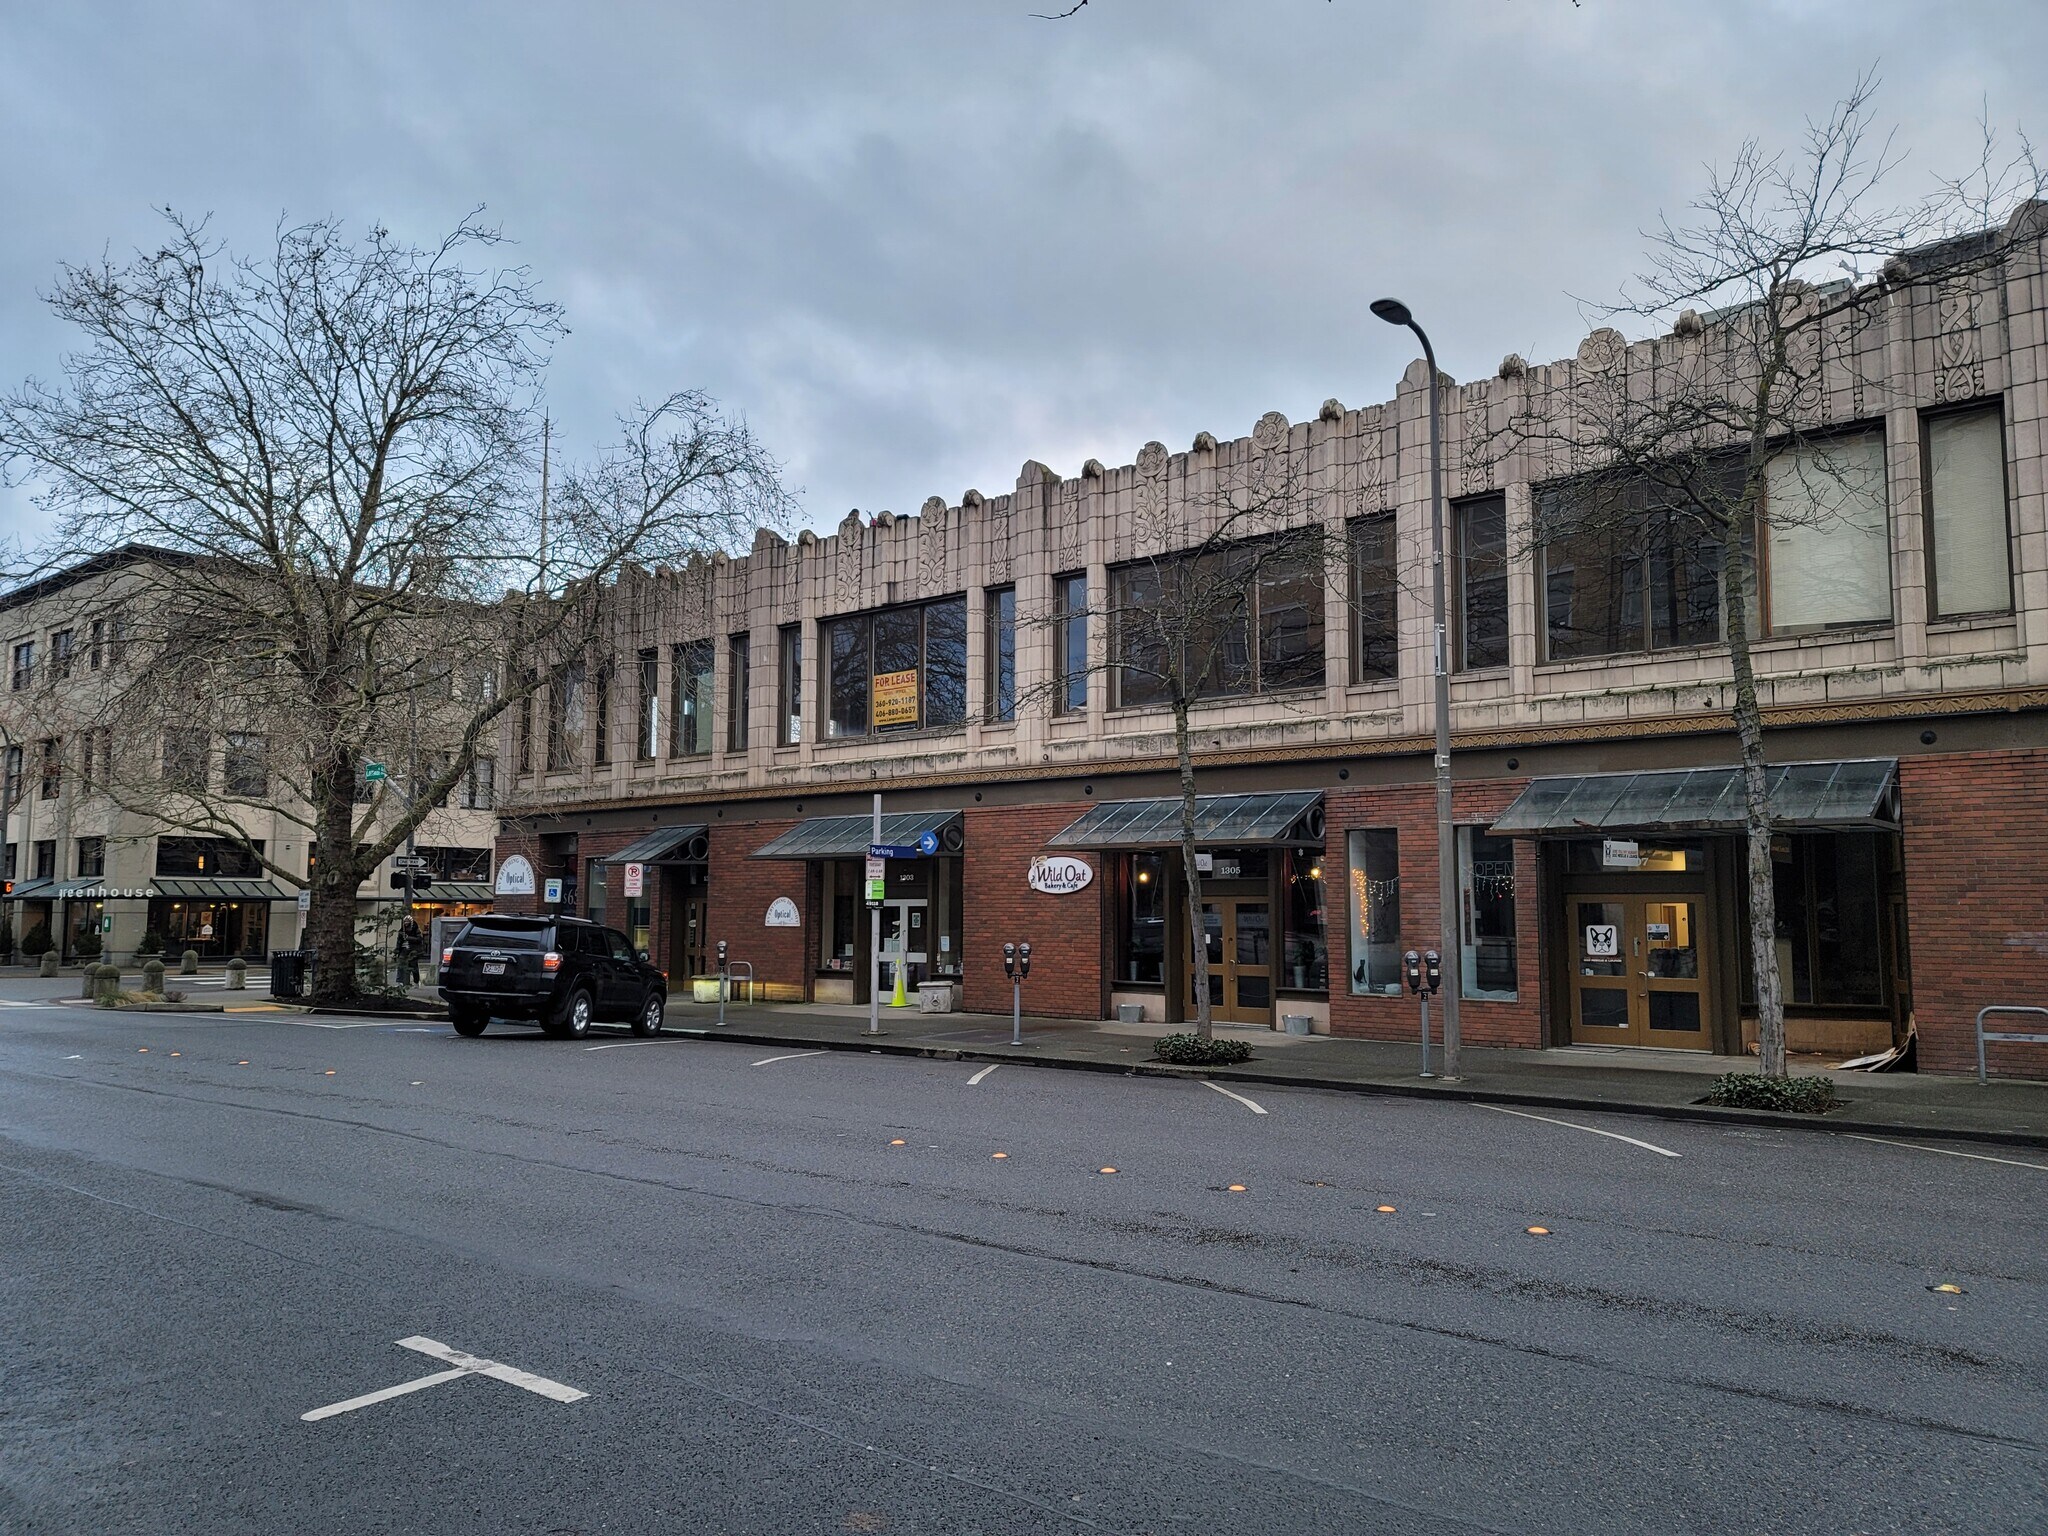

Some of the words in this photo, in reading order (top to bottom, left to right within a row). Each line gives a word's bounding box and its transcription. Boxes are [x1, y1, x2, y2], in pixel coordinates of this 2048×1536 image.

[875, 677, 889, 688] FOR
[891, 672, 915, 686] LEASE
[871, 847, 894, 858] Parking
[1036, 865, 1063, 882] Wild
[1065, 865, 1086, 882] Oat
[1220, 866, 1241, 875] 1305
[1474, 862, 1513, 876] OPEN
[505, 872, 525, 885] Optical
[1045, 882, 1061, 890] Bakery
[59, 886, 154, 900] greenhouse
